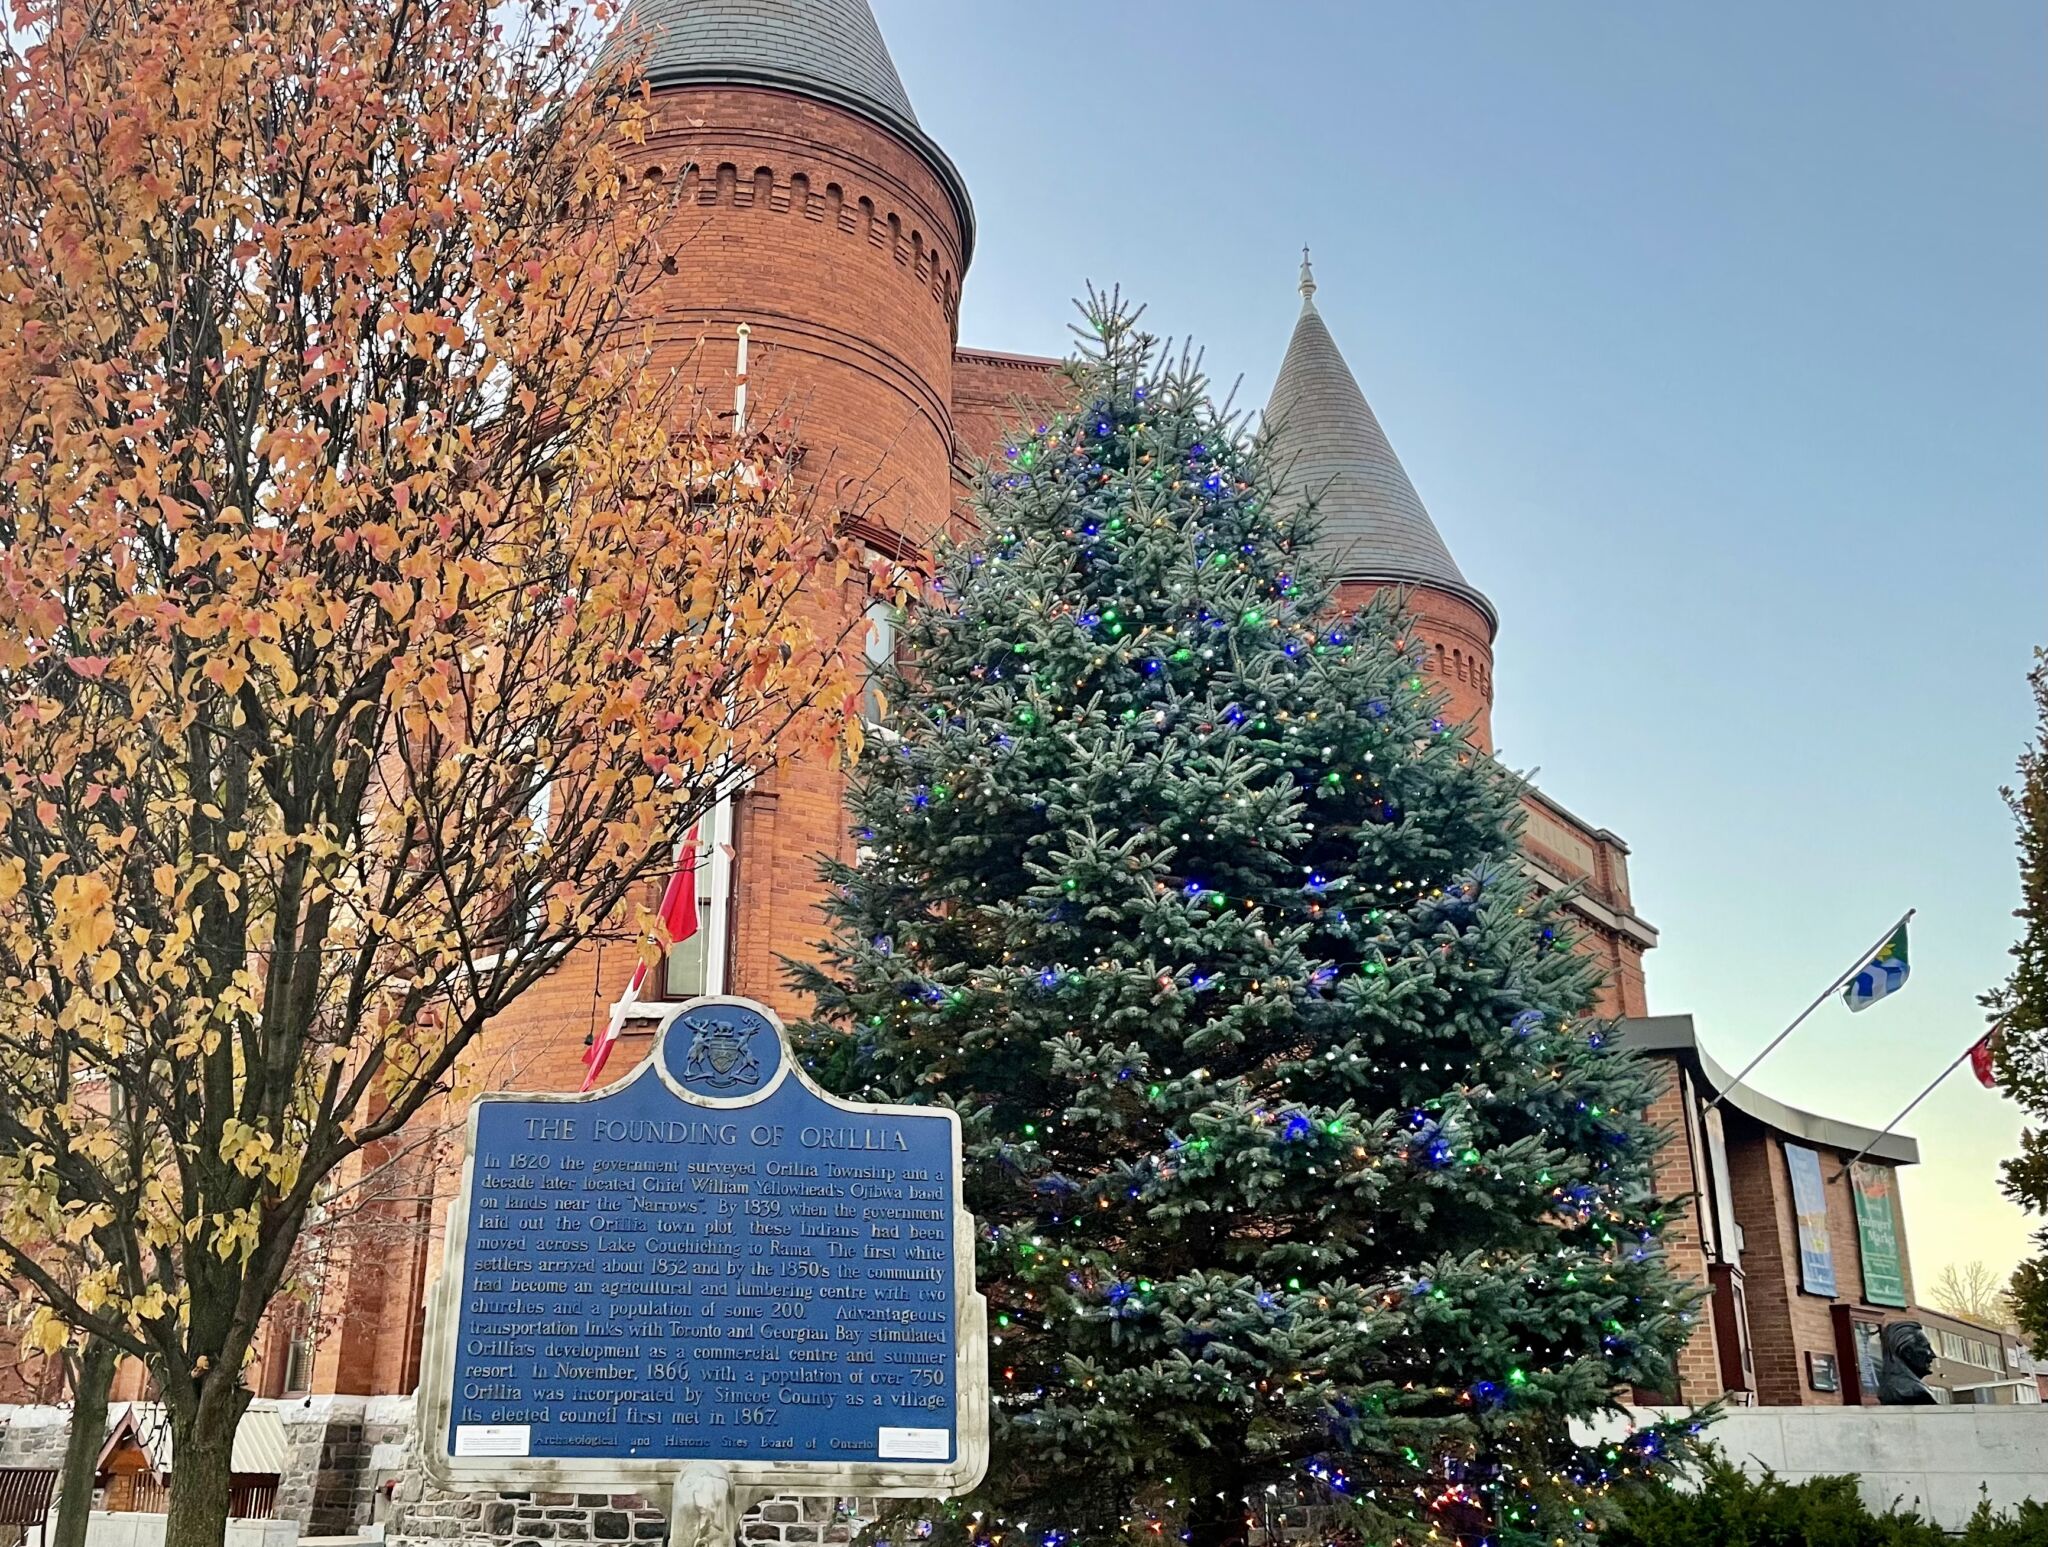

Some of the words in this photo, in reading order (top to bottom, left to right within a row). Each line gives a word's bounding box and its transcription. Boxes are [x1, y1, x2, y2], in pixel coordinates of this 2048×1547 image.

[524, 1117, 576, 1140] THE
[592, 1118, 737, 1146] FOUNDING
[751, 1125, 784, 1147] OF
[801, 1127, 909, 1151] ORILLIA
[484, 1153, 500, 1169] In
[509, 1154, 550, 1169] 1820
[560, 1156, 584, 1170] the
[592, 1159, 679, 1174] government
[687, 1159, 756, 1178] surveyed
[767, 1161, 819, 1177] Orillia
[825, 1163, 895, 1182] Township
[903, 1167, 927, 1181] and
[936, 1171, 943, 1181] a
[482, 1174, 534, 1189] decade
[541, 1176, 576, 1190] later
[583, 1176, 635, 1191] located
[643, 1177, 684, 1193] Chief
[691, 1177, 749, 1195] William
[755, 1181, 844, 1197] Yellowhead's
[850, 1183, 902, 1199] Ojibwa
[910, 1186, 943, 1200] band
[480, 1196, 497, 1208] on
[505, 1195, 547, 1209] lands
[555, 1199, 590, 1210] near
[598, 1198, 621, 1211] the
[718, 1199, 738, 1215] By
[790, 1204, 827, 1217] when
[835, 1203, 857, 1217] the
[863, 1207, 944, 1221] government
[479, 1215, 508, 1229] laid
[519, 1217, 544, 1230] out
[556, 1217, 580, 1231] the
[589, 1215, 647, 1232] Orillia
[657, 1219, 695, 1233] town
[750, 1221, 791, 1235] these
[801, 1222, 859, 1237] Indians
[872, 1224, 899, 1238] had
[910, 1225, 944, 1240] been
[477, 1236, 526, 1251] moved
[536, 1239, 589, 1251] across
[598, 1237, 636, 1252] Lake
[645, 1237, 741, 1258] Couchiching
[749, 1244, 763, 1255] to
[828, 1242, 854, 1258] The
[863, 1244, 897, 1259] first
[905, 1246, 945, 1260] white
[474, 1257, 532, 1272] settlers
[538, 1258, 595, 1272] arrived
[602, 1259, 644, 1273] about
[651, 1260, 687, 1275] 1832
[693, 1261, 720, 1275] and
[727, 1261, 745, 1278] by
[751, 1261, 774, 1276] the
[837, 1264, 860, 1278] the
[867, 1266, 946, 1281] community
[473, 1278, 501, 1292] had
[511, 1279, 567, 1293] become
[574, 1282, 592, 1293] an
[601, 1281, 692, 1297] agricultural
[701, 1282, 727, 1295] and
[736, 1282, 812, 1300] lumbering
[820, 1286, 866, 1299] centre
[874, 1287, 910, 1300] with
[918, 1288, 945, 1301] two
[471, 1298, 544, 1314] churches
[554, 1300, 582, 1315] and
[591, 1305, 600, 1315] a
[609, 1300, 692, 1319] population
[701, 1301, 715, 1316] of
[725, 1304, 763, 1317] some
[835, 1305, 946, 1324] Advantageous
[470, 1321, 578, 1339] transportation
[585, 1322, 623, 1336] links
[629, 1322, 663, 1337] with
[670, 1322, 721, 1338] Toronto
[727, 1324, 754, 1338] and
[760, 1324, 828, 1342] Georgian
[835, 1325, 863, 1344] Bay
[869, 1327, 946, 1343] stimulated
[467, 1340, 535, 1356] Orillia's
[545, 1343, 640, 1361] development
[649, 1347, 666, 1358] as
[676, 1348, 685, 1359] a
[694, 1346, 780, 1361] commercial
[789, 1347, 837, 1361] centre
[846, 1347, 874, 1362] and
[884, 1351, 946, 1364] summer
[532, 1363, 547, 1378] In
[701, 1366, 736, 1381] with
[745, 1371, 753, 1382] a
[761, 1368, 842, 1385] population
[850, 1369, 864, 1383] of
[871, 1371, 903, 1384] over
[464, 1384, 521, 1400] Orillia
[533, 1389, 564, 1401] was
[572, 1387, 673, 1405] incorporated
[685, 1387, 703, 1405] by
[714, 1387, 770, 1401] Simcoe
[778, 1388, 837, 1408] County
[845, 1394, 864, 1405] as
[874, 1396, 882, 1406] a
[461, 1406, 481, 1422] Its
[491, 1407, 550, 1422] elected
[560, 1408, 617, 1424] council
[626, 1408, 662, 1425] first
[672, 1410, 699, 1425] met
[710, 1411, 725, 1425] in
[631, 1436, 650, 1446] and
[761, 1437, 794, 1448] Board
[806, 1438, 816, 1449] of
